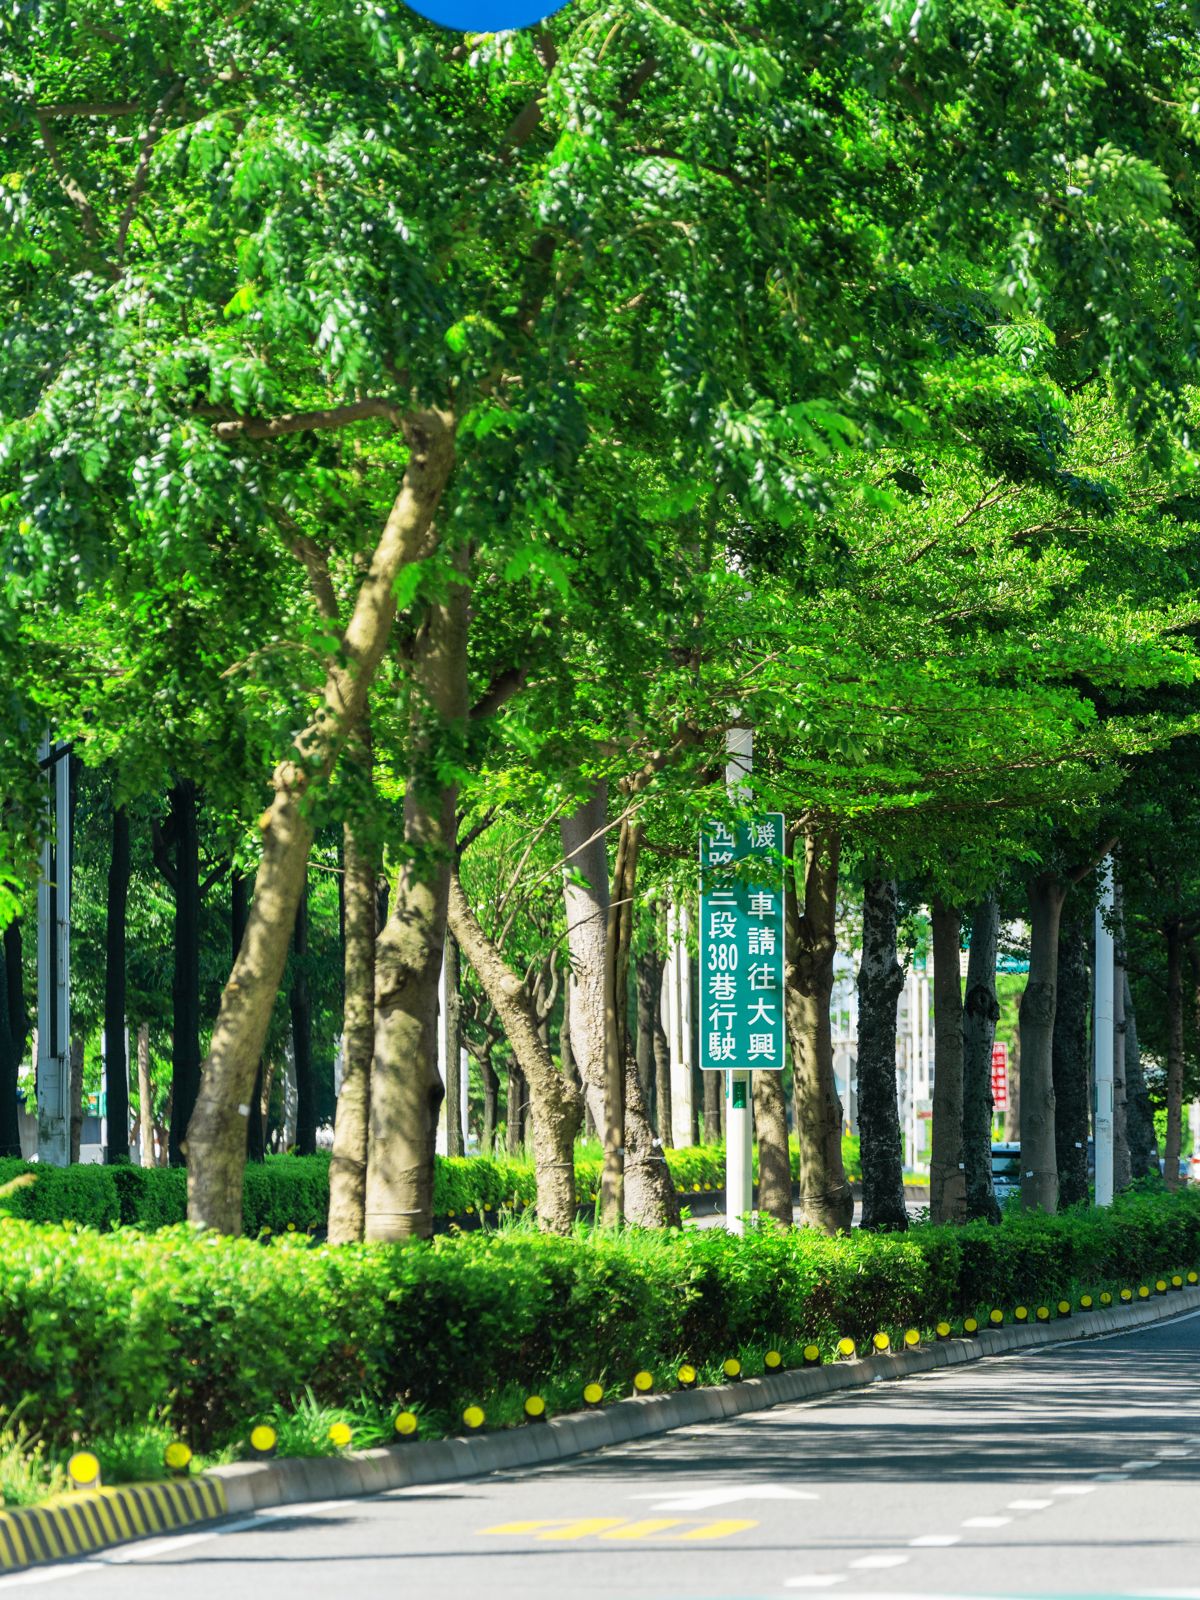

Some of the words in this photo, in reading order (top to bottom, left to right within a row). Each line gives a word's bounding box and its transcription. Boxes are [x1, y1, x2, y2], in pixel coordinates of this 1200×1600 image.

[747, 821, 776, 1061] 機車請往大興
